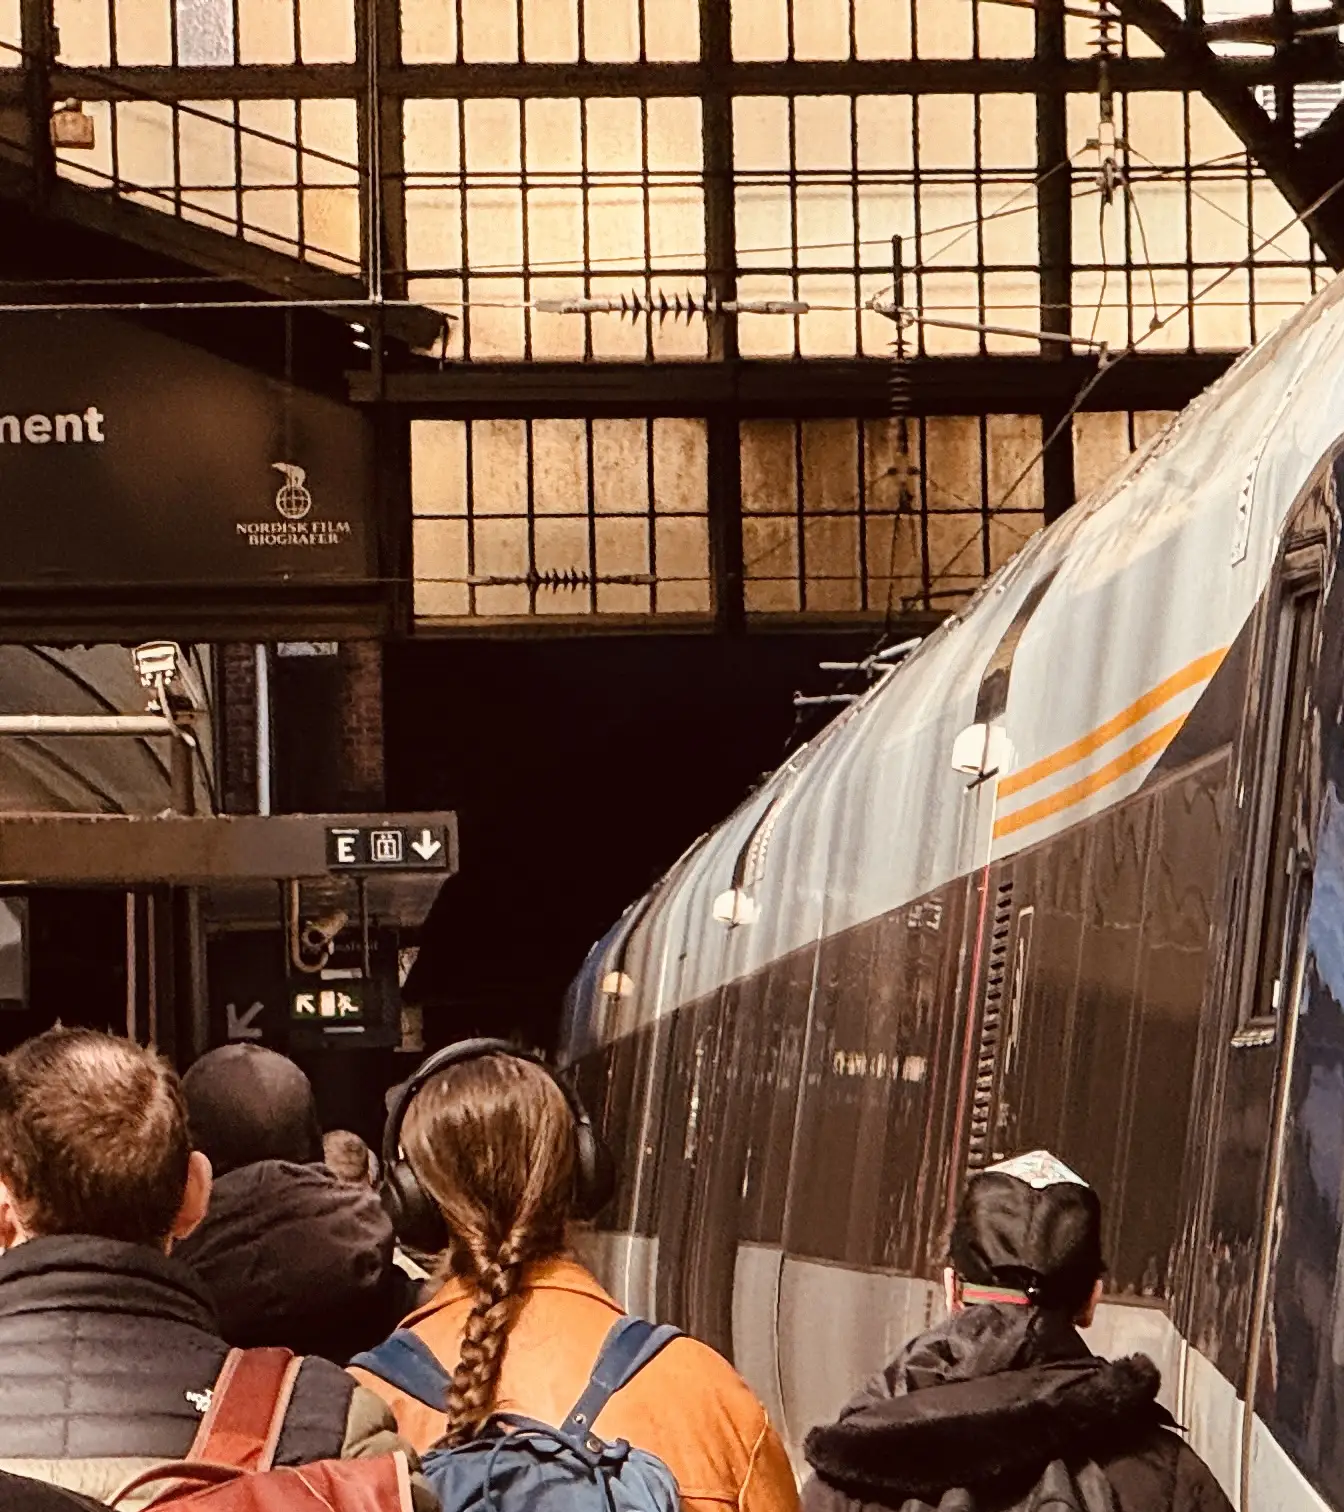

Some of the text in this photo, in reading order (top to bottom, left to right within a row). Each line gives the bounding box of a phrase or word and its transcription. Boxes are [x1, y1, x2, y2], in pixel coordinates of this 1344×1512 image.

[236, 520, 352, 534] NORDISK FILM
[337, 835, 356, 863] E
